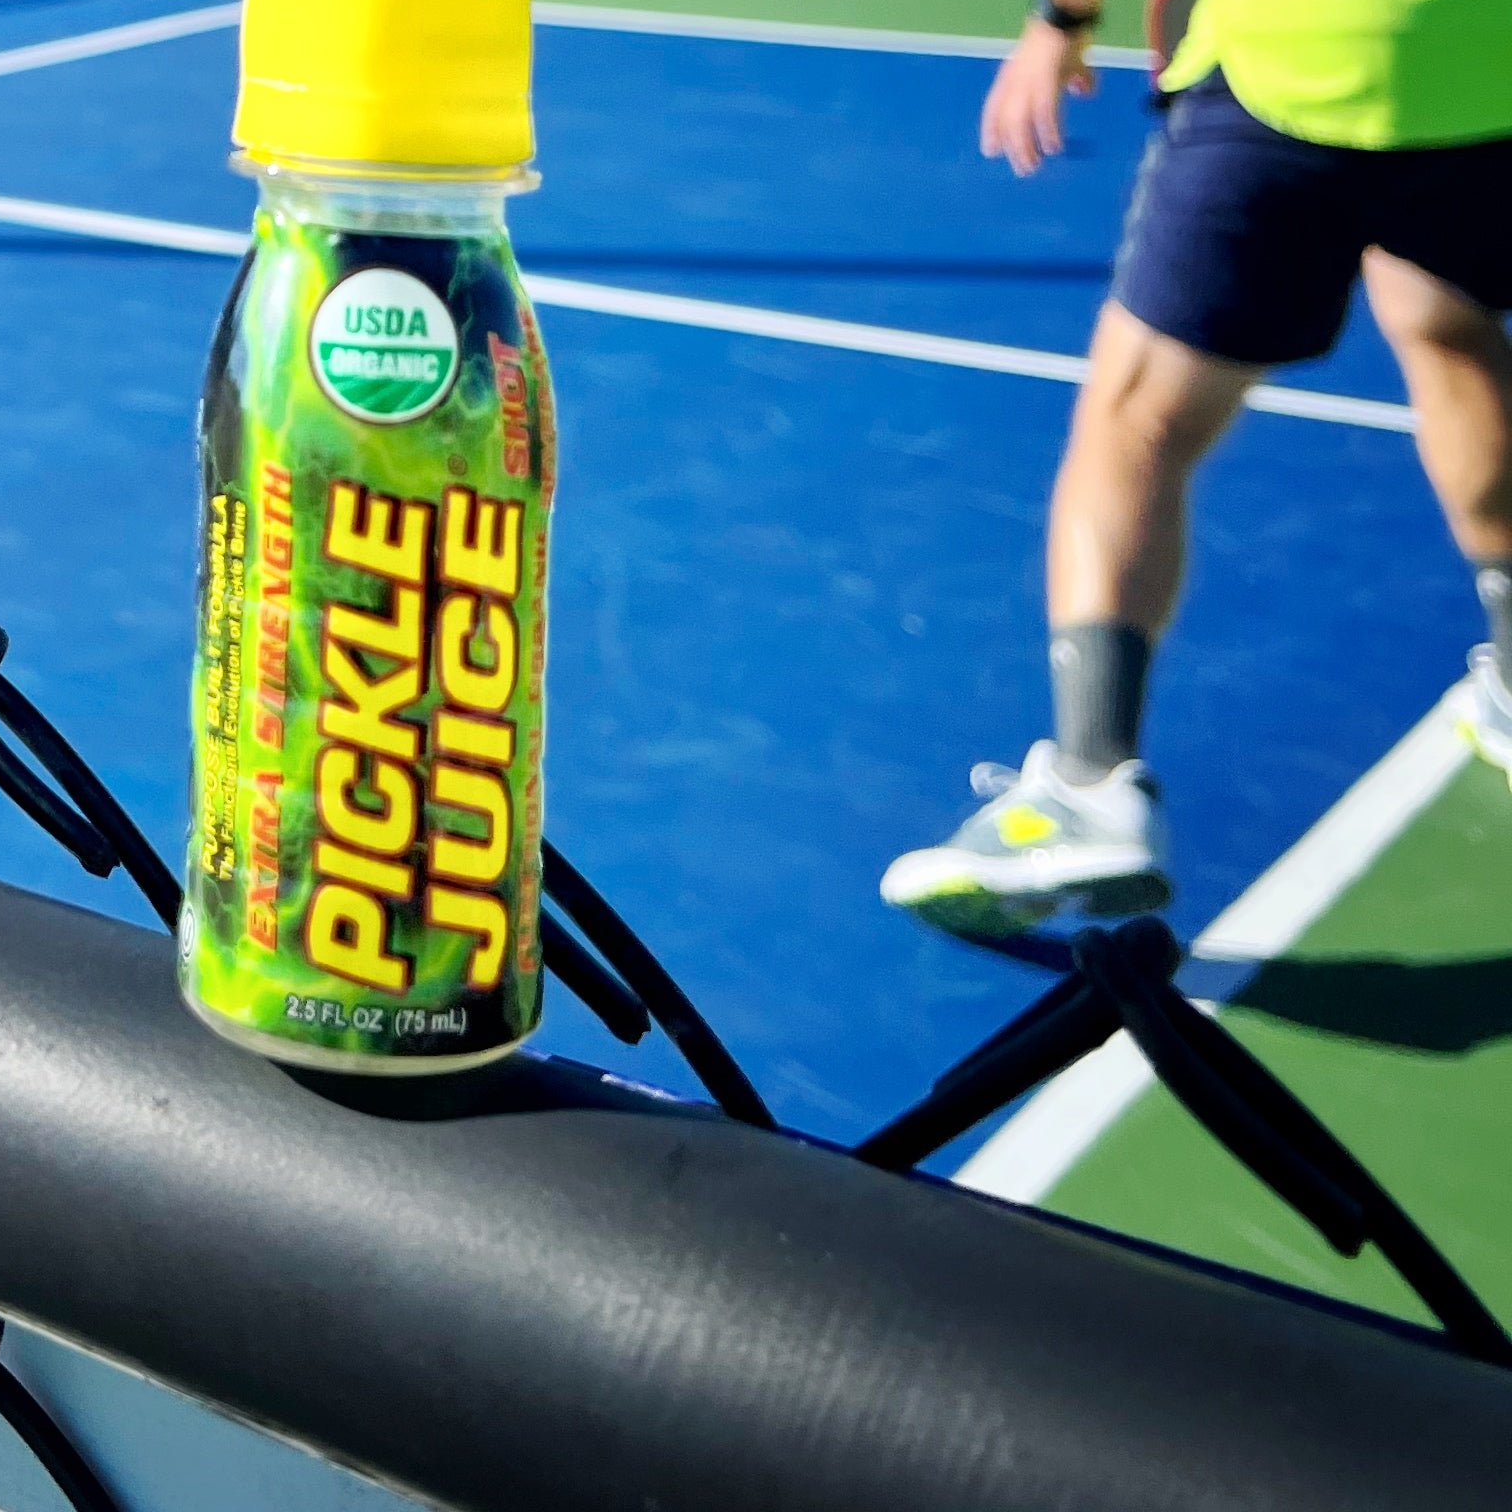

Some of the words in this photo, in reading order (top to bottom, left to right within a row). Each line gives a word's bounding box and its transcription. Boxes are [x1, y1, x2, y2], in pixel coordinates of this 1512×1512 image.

[329, 346, 440, 383] ORGANIC
[345, 304, 428, 337] USDA
[487, 330, 530, 479] SHOT
[207, 494, 228, 636] FORMULA
[230, 501, 246, 556] Brine
[228, 616, 242, 640] of
[229, 559, 244, 614] Pickle
[254, 461, 294, 750] STRENGTH
[223, 645, 241, 737] Evolution
[304, 478, 436, 994] PICKLE
[425, 484, 526, 990] JUICE
[202, 734, 222, 874] PURPOSE
[220, 739, 238, 840] Functional
[247, 771, 284, 952] EXTRA
[287, 995, 316, 1021] 2.5
[321, 1002, 347, 1027] FL
[353, 1007, 383, 1032] OZ
[395, 1008, 426, 1037] (75
[430, 1006, 467, 1036] mL)
